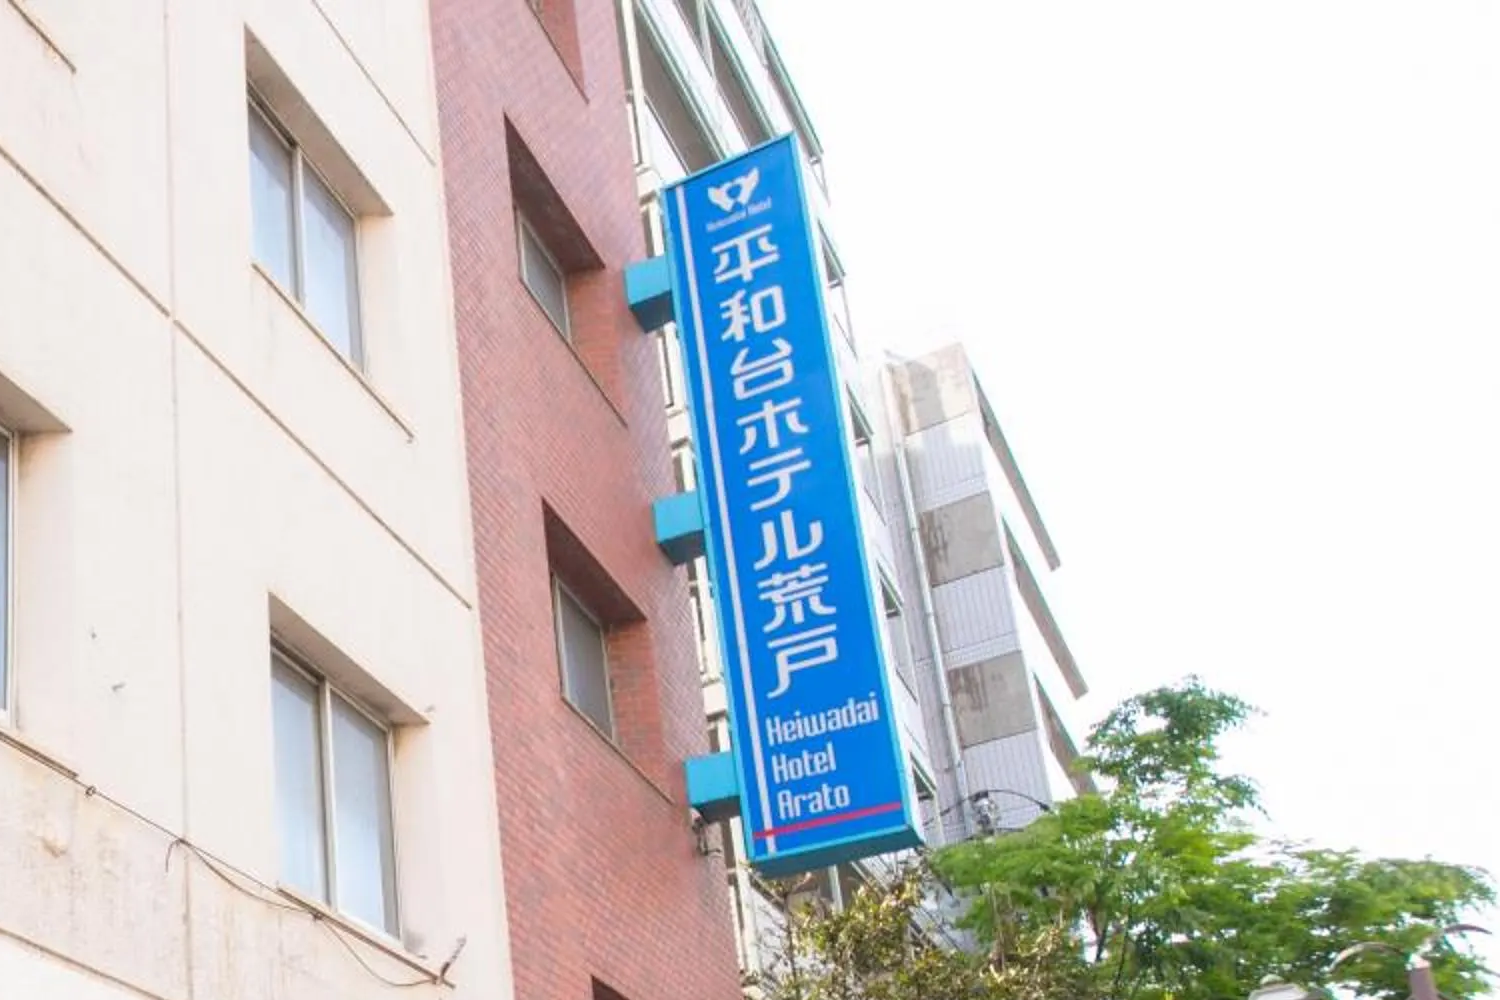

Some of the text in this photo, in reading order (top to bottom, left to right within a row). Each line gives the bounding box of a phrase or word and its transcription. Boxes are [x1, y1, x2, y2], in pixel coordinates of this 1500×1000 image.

[711, 223, 839, 699] 平和台ホテル荒戸
[765, 691, 880, 746] Heiwadai
[772, 741, 837, 784] Hotel
[777, 783, 850, 821] Arato
